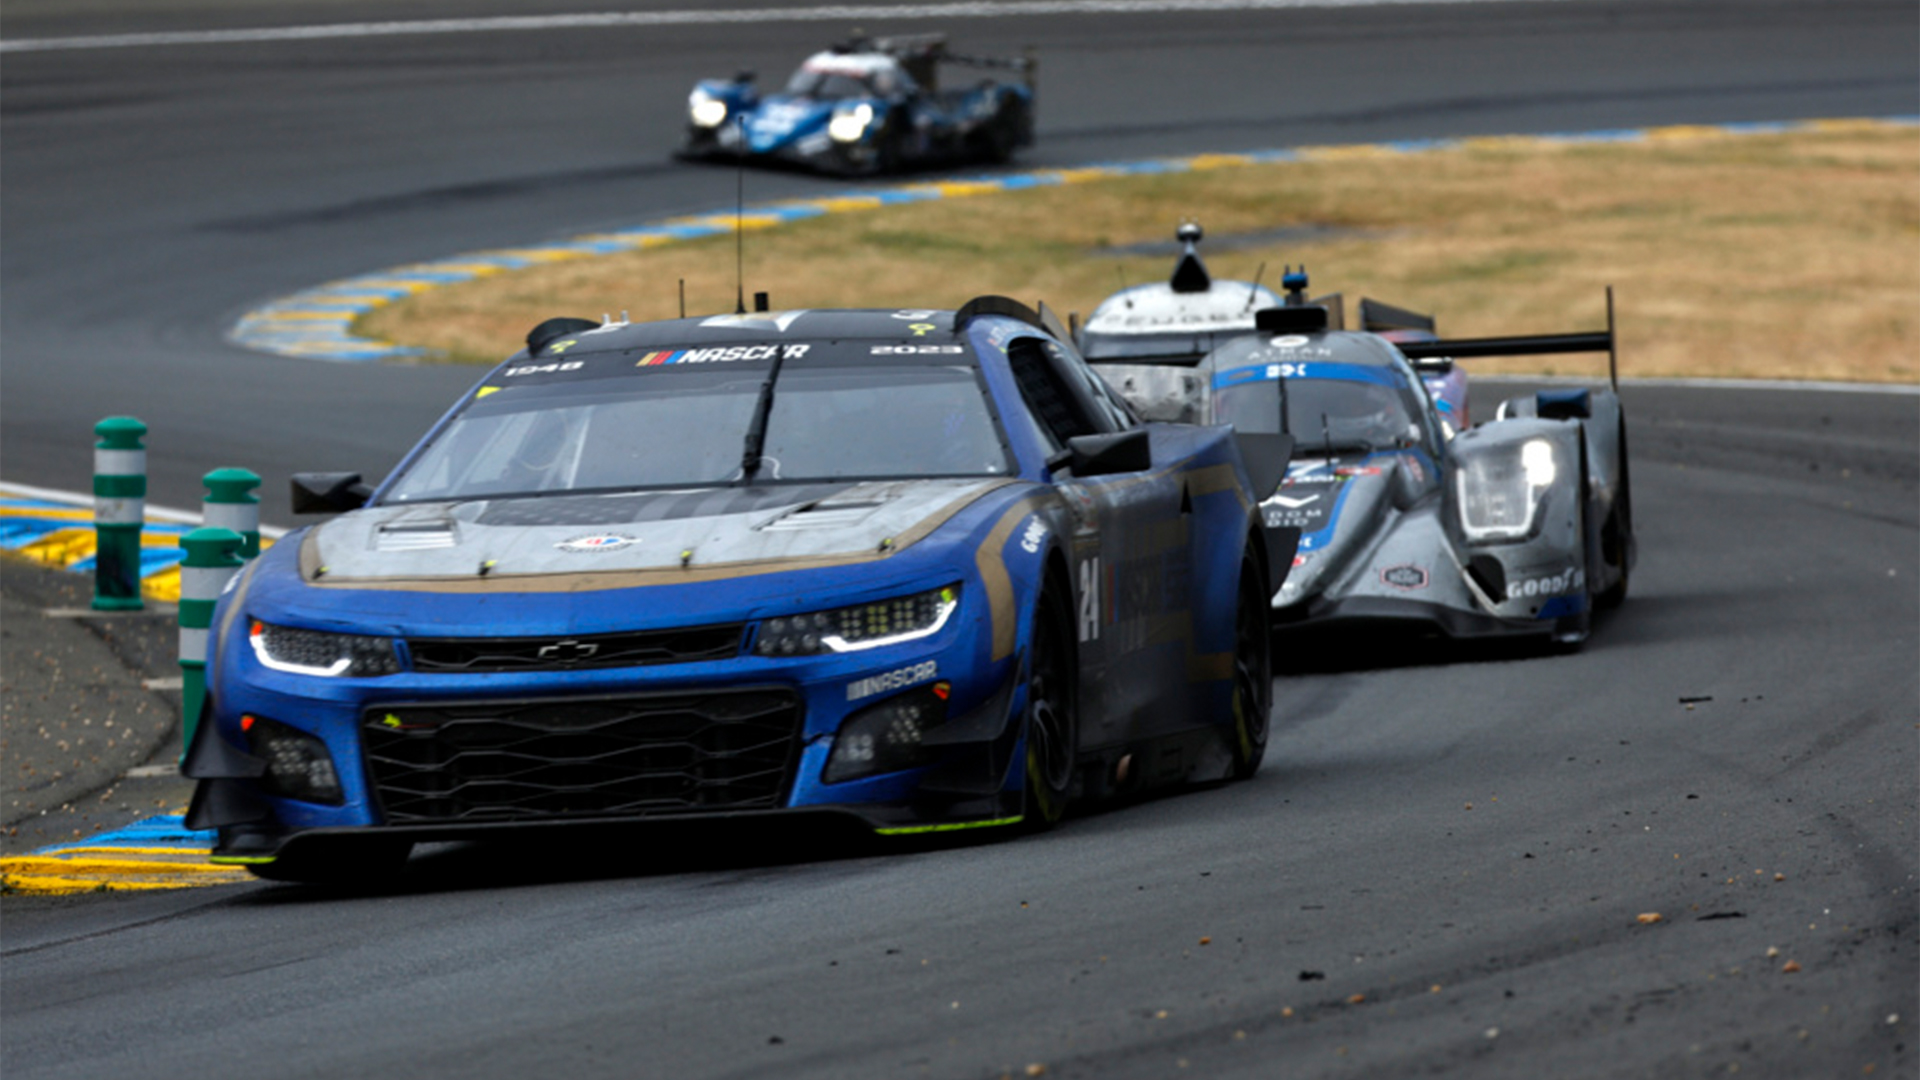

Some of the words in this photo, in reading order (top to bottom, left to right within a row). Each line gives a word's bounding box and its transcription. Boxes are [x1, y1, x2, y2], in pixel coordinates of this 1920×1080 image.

[870, 345, 963, 355] 2023
[505, 361, 584, 376] 1948
[863, 660, 937, 697] NASCAR
